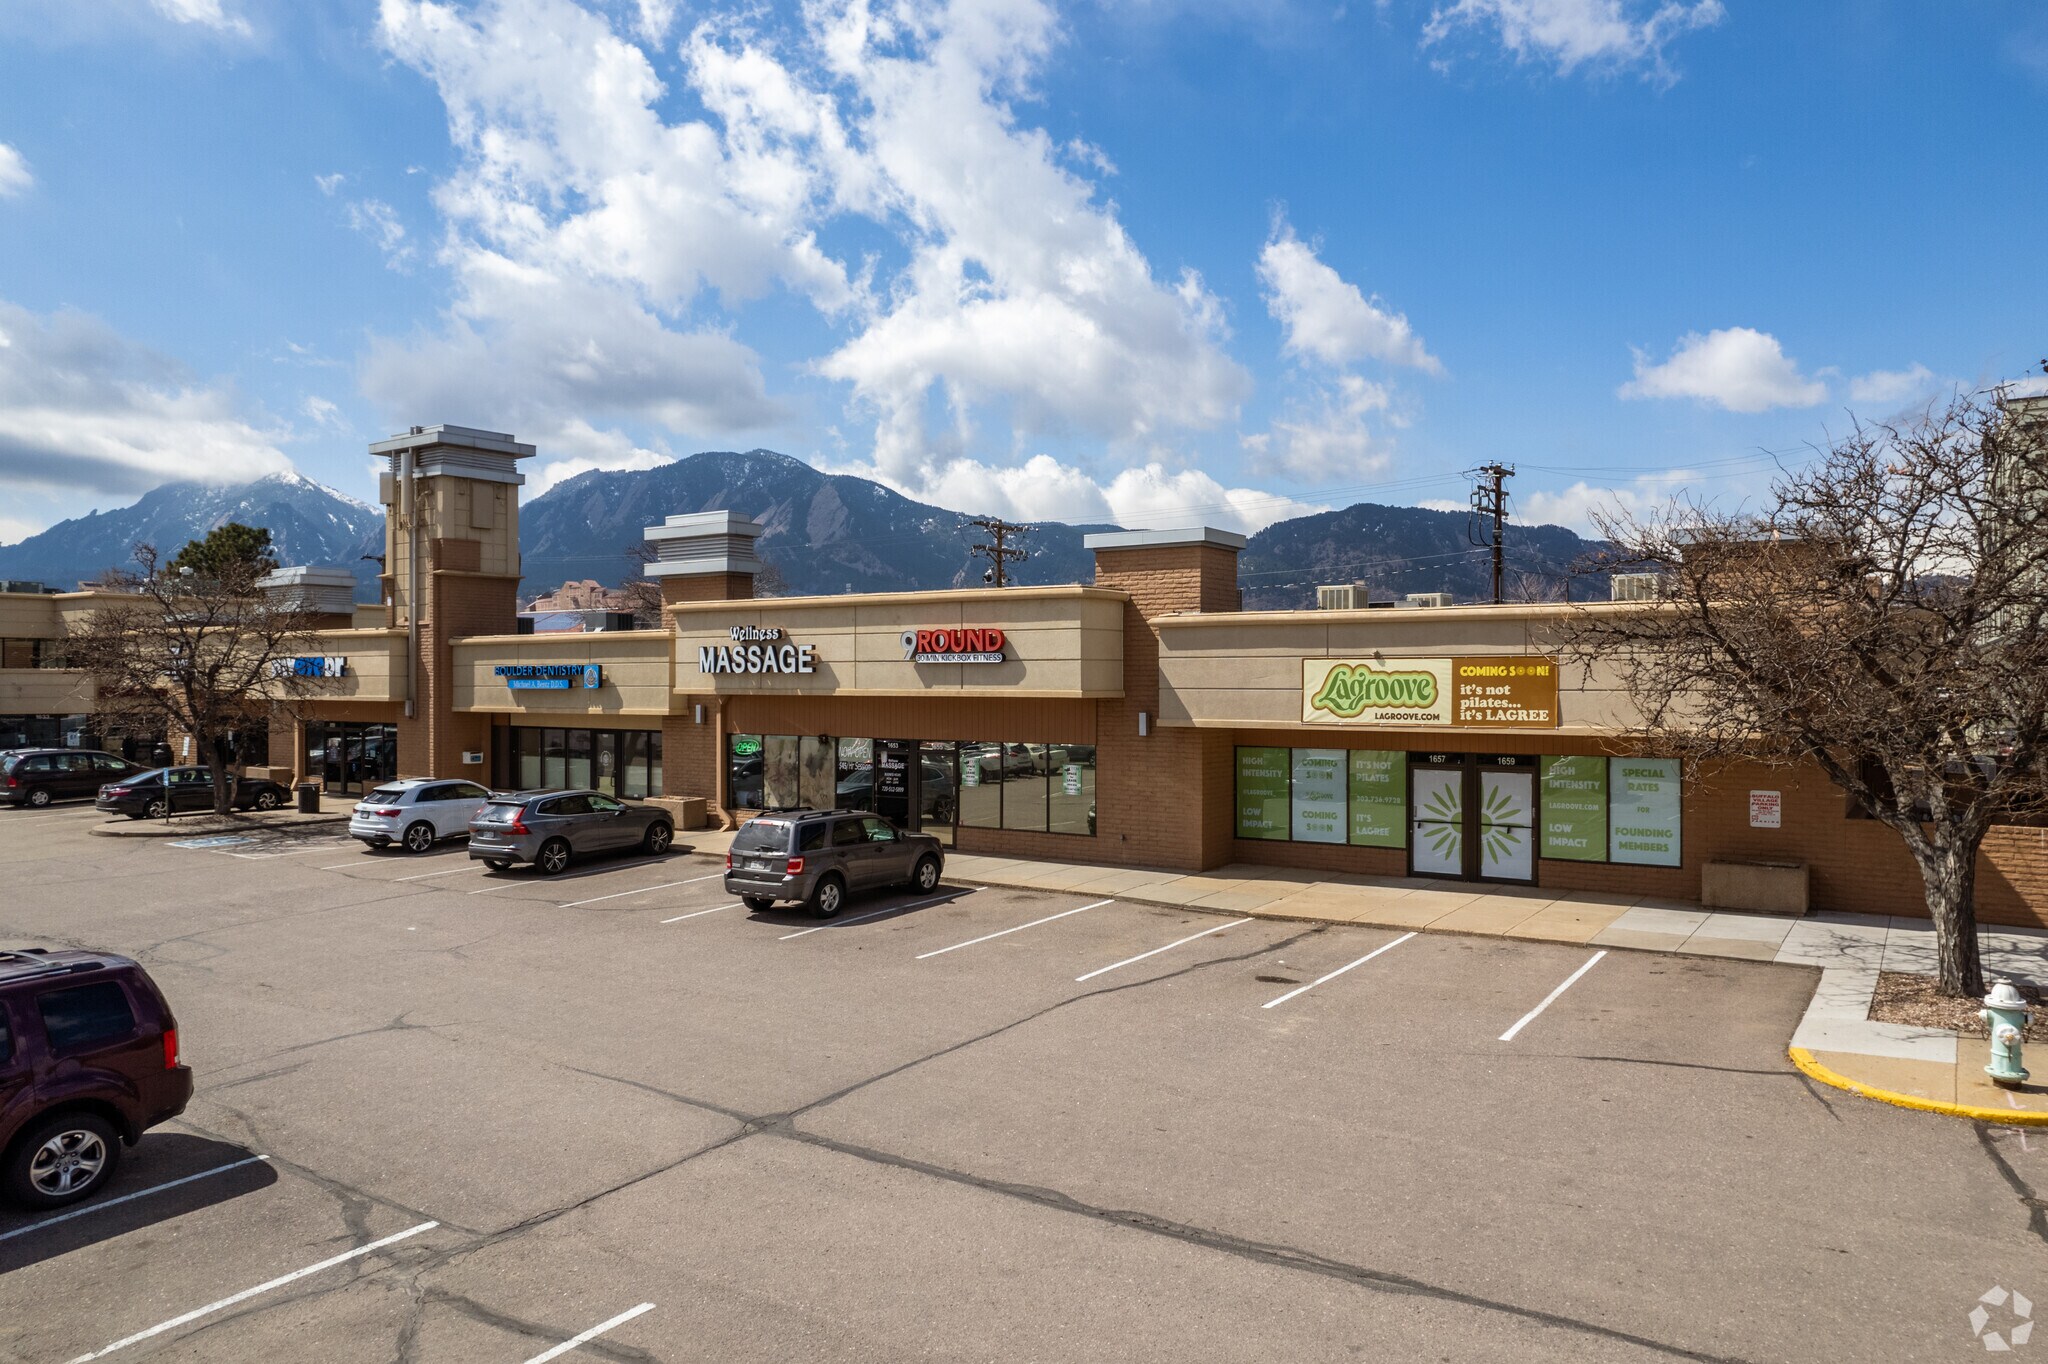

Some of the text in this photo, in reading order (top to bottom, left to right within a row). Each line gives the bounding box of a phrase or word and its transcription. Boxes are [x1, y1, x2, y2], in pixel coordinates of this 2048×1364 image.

[730, 626, 779, 641] Wellness
[699, 645, 814, 674] MASSAGE
[941, 653, 972, 661] KICKBOX
[973, 653, 1001, 661] FITNESS
[495, 665, 584, 676] BOULDER DENTISTRY
[1460, 665, 1549, 676] COMING SOON!
[513, 680, 531, 688] Michael
[1319, 670, 1431, 711] Lagroove
[1460, 684, 1511, 695] it's not
[1460, 697, 1521, 709] pilates...
[1460, 708, 1549, 721] it's LAGREE
[737, 742, 757, 752] OPEN
[839, 746, 872, 759] NOW OPEN
[1242, 757, 1264, 765] HIGH
[1302, 759, 1338, 767] COMING
[1429, 755, 1446, 763] 1657
[1497, 757, 1515, 766] 1659
[1356, 761, 1392, 770] IT'S NOT
[1242, 769, 1283, 778] INTENSITY
[1549, 766, 1576, 775] HIGH
[1622, 768, 1665, 778] SPECIAL
[1356, 774, 1390, 782] PILATES
[1549, 779, 1600, 790] INTENSITY
[1628, 782, 1660, 792] RATES
[1549, 802, 1599, 811] LAGROOVE.COM
[1242, 808, 1261, 816] LOW
[1302, 811, 1338, 820] COMING
[1356, 814, 1372, 822] IT'S
[1242, 820, 1273, 829] IMPACT
[1549, 824, 1573, 833] LOW
[1356, 827, 1390, 836] LAGREE
[1616, 827, 1673, 838] FOUNDING
[1549, 837, 1588, 848] IMPACT
[1619, 841, 1670, 853] MEMBERS
